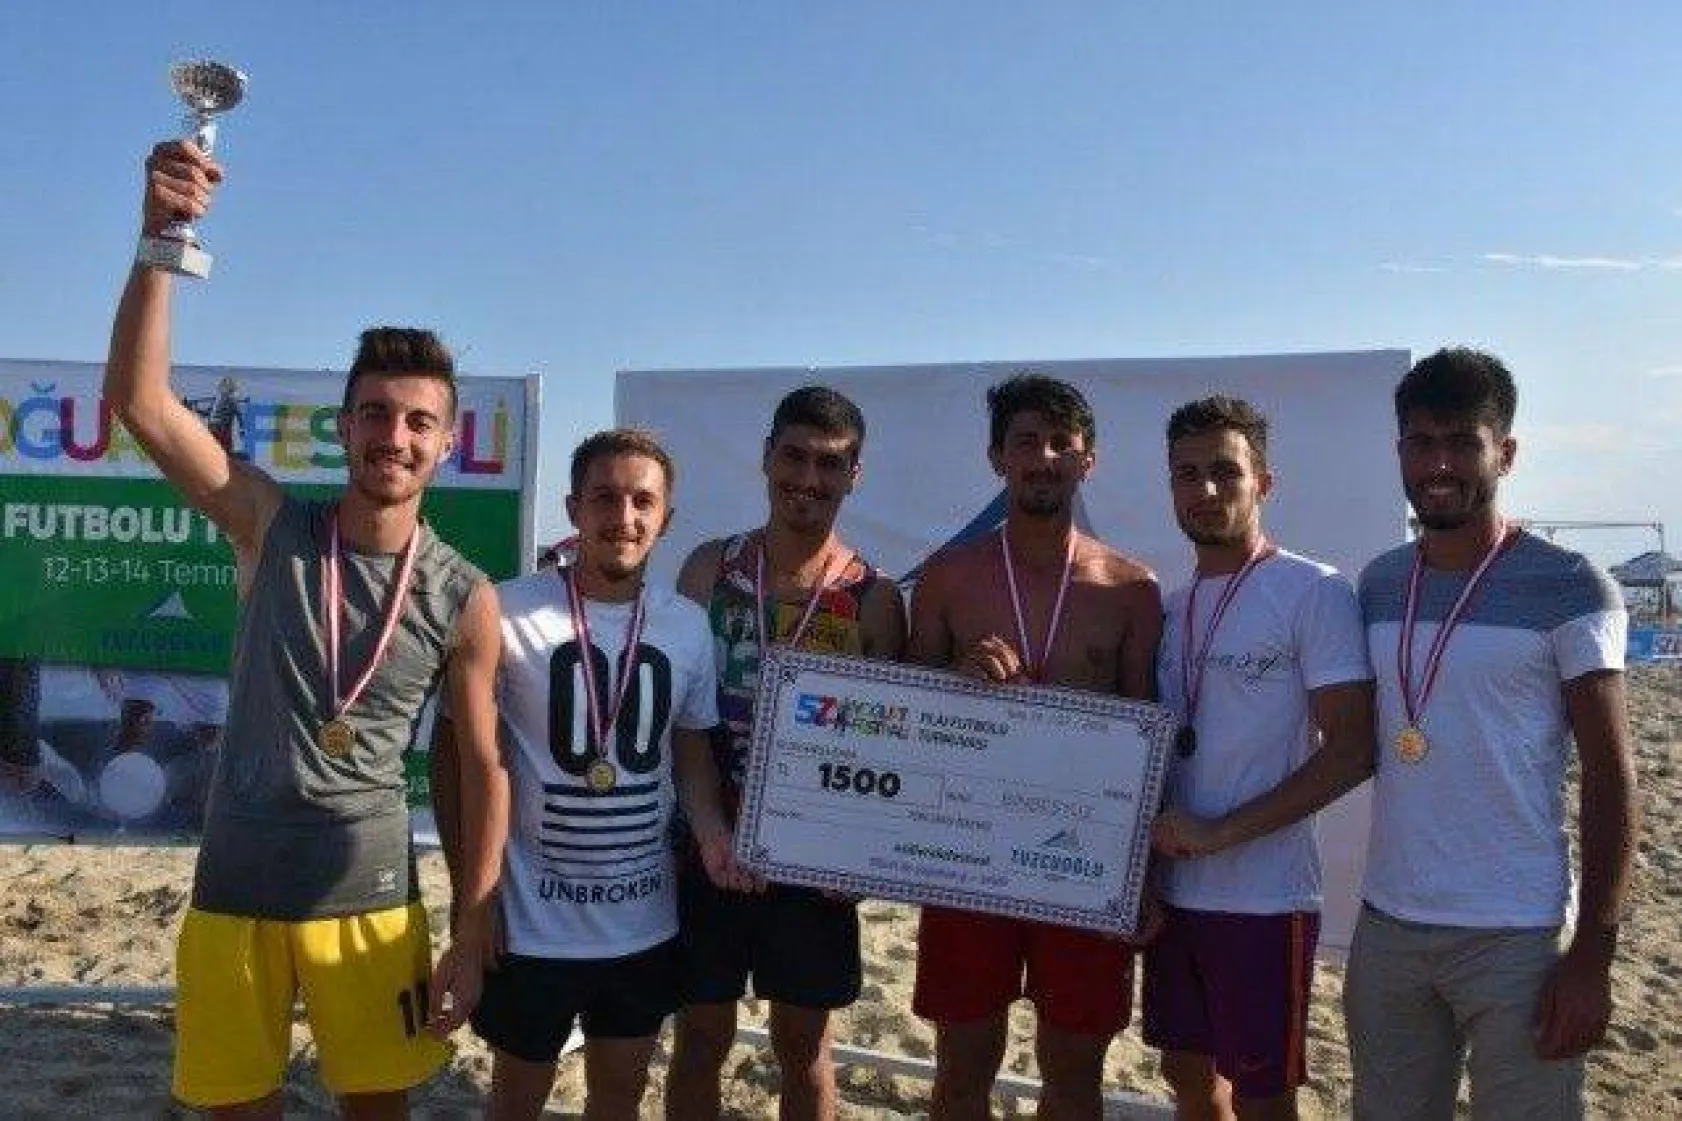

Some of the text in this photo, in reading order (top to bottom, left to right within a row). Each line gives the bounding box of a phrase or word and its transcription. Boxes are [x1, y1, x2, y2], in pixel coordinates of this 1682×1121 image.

[4, 502, 190, 543] FUTBOLU
[43, 556, 148, 587] 12-13-14
[818, 762, 901, 798] 1500
[538, 874, 662, 904] UNBROKEN
